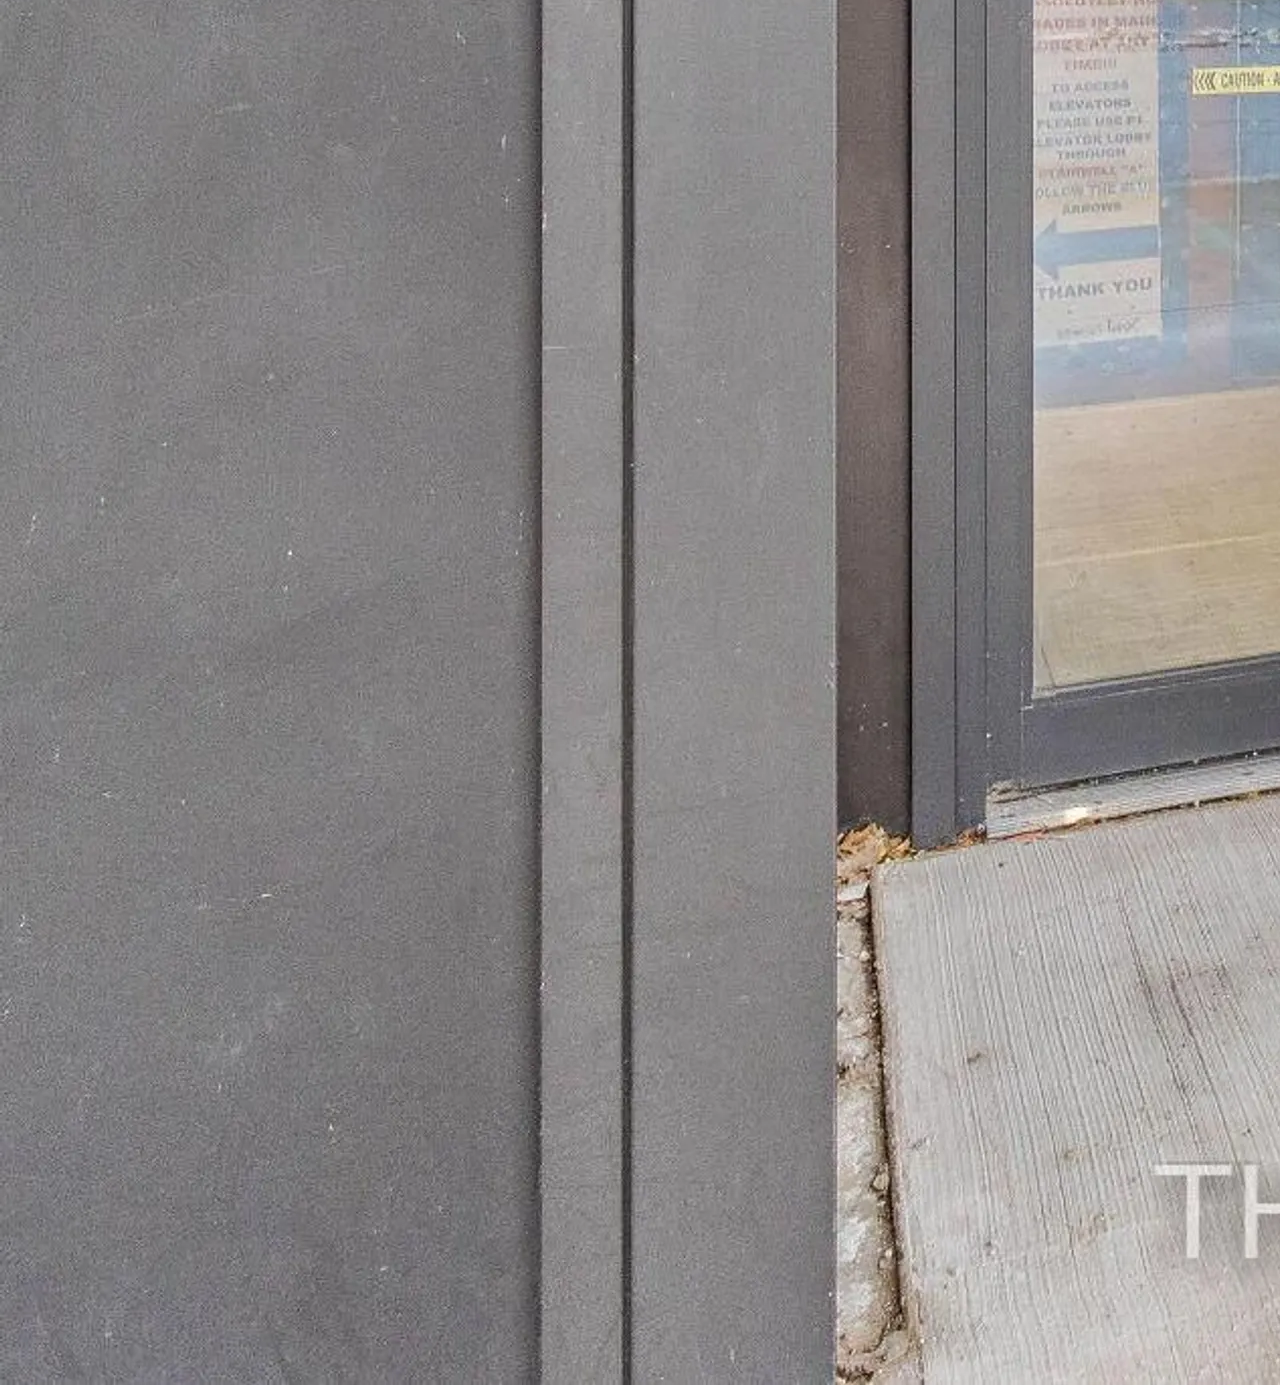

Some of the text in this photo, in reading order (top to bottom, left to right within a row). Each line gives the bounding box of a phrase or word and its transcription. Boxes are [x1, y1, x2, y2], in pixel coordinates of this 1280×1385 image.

[1051, 79, 1129, 93] TO ACCESS
[1220, 71, 1265, 89] CAUTION
[1048, 97, 1132, 112] ELEVATORS
[1036, 117, 1091, 129] PLEASE
[1095, 116, 1122, 127] USE
[1035, 131, 1152, 147] LEVATOR LOBBY
[1056, 147, 1126, 161] THROUGH
[1035, 184, 1084, 200] OLLOW
[1062, 201, 1123, 216] ARROWS
[1036, 276, 1152, 300] THANK YOU
